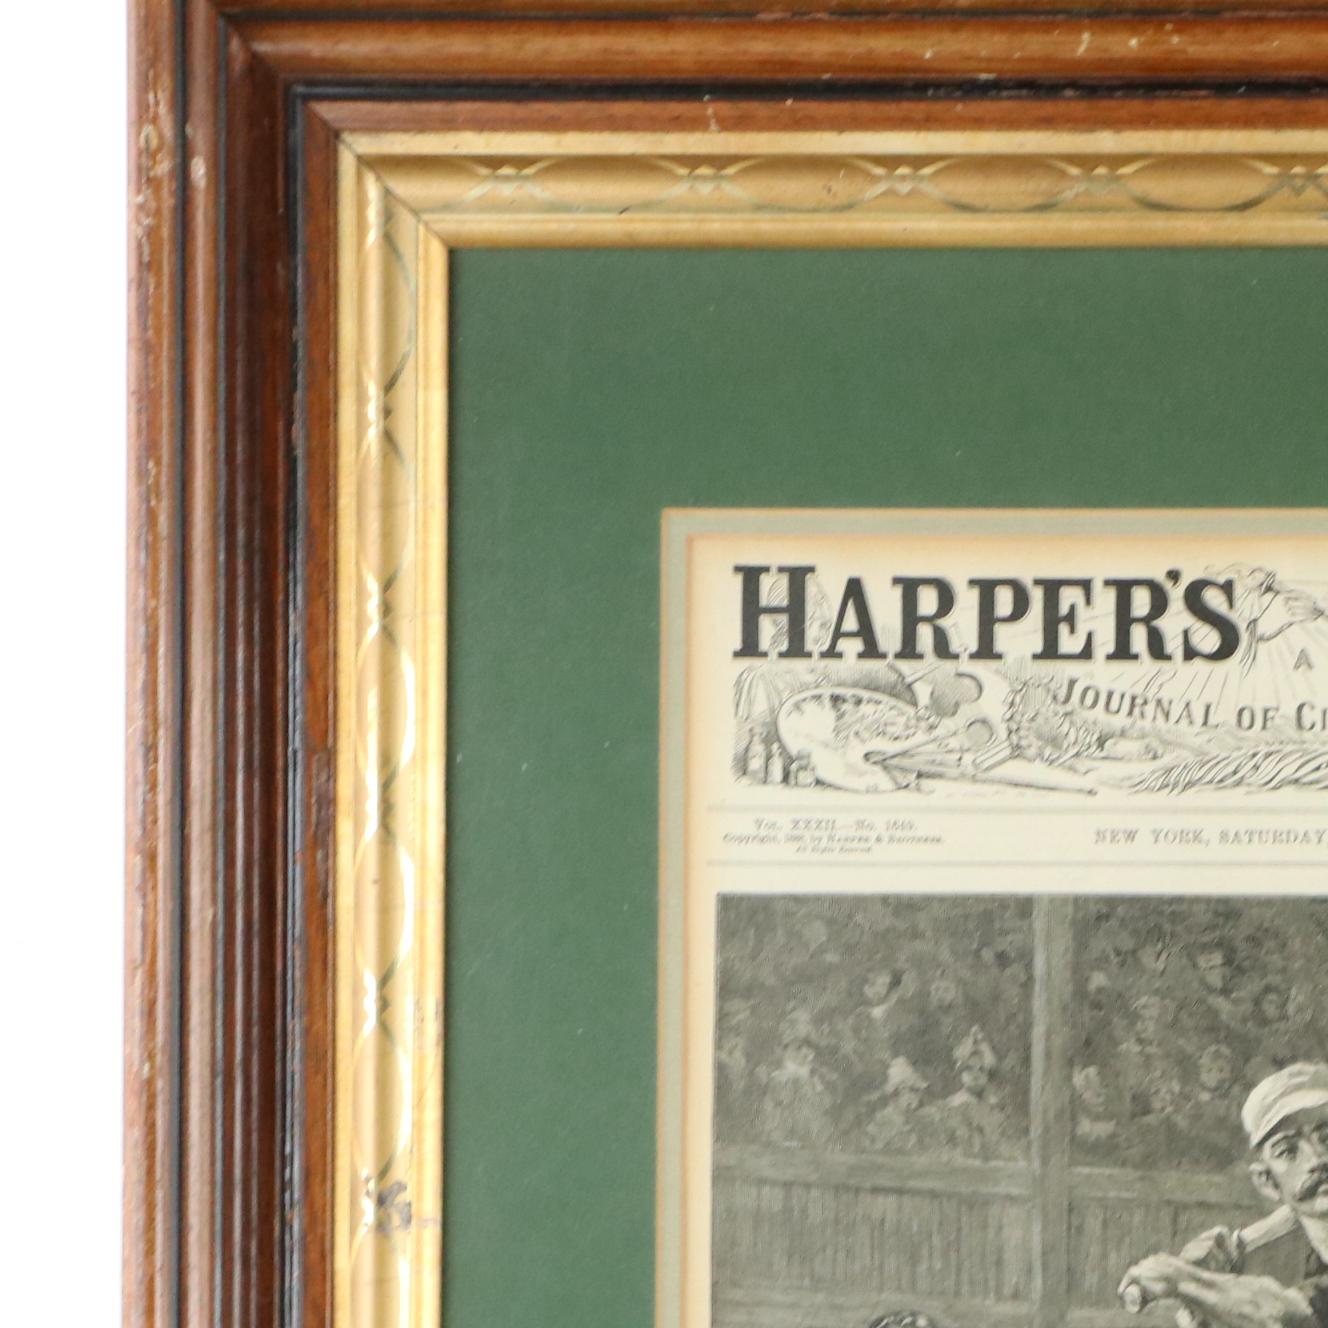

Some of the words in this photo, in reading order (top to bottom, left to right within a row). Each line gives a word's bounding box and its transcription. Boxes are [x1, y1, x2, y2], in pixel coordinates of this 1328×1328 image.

[732, 565, 1240, 661] HARPER'S
[1293, 648, 1313, 671] A
[1052, 677, 1220, 729] JOURNAL
[1236, 705, 1278, 730] OF
[1093, 828, 1140, 845] NEW
[1149, 828, 1210, 847] YORK,
